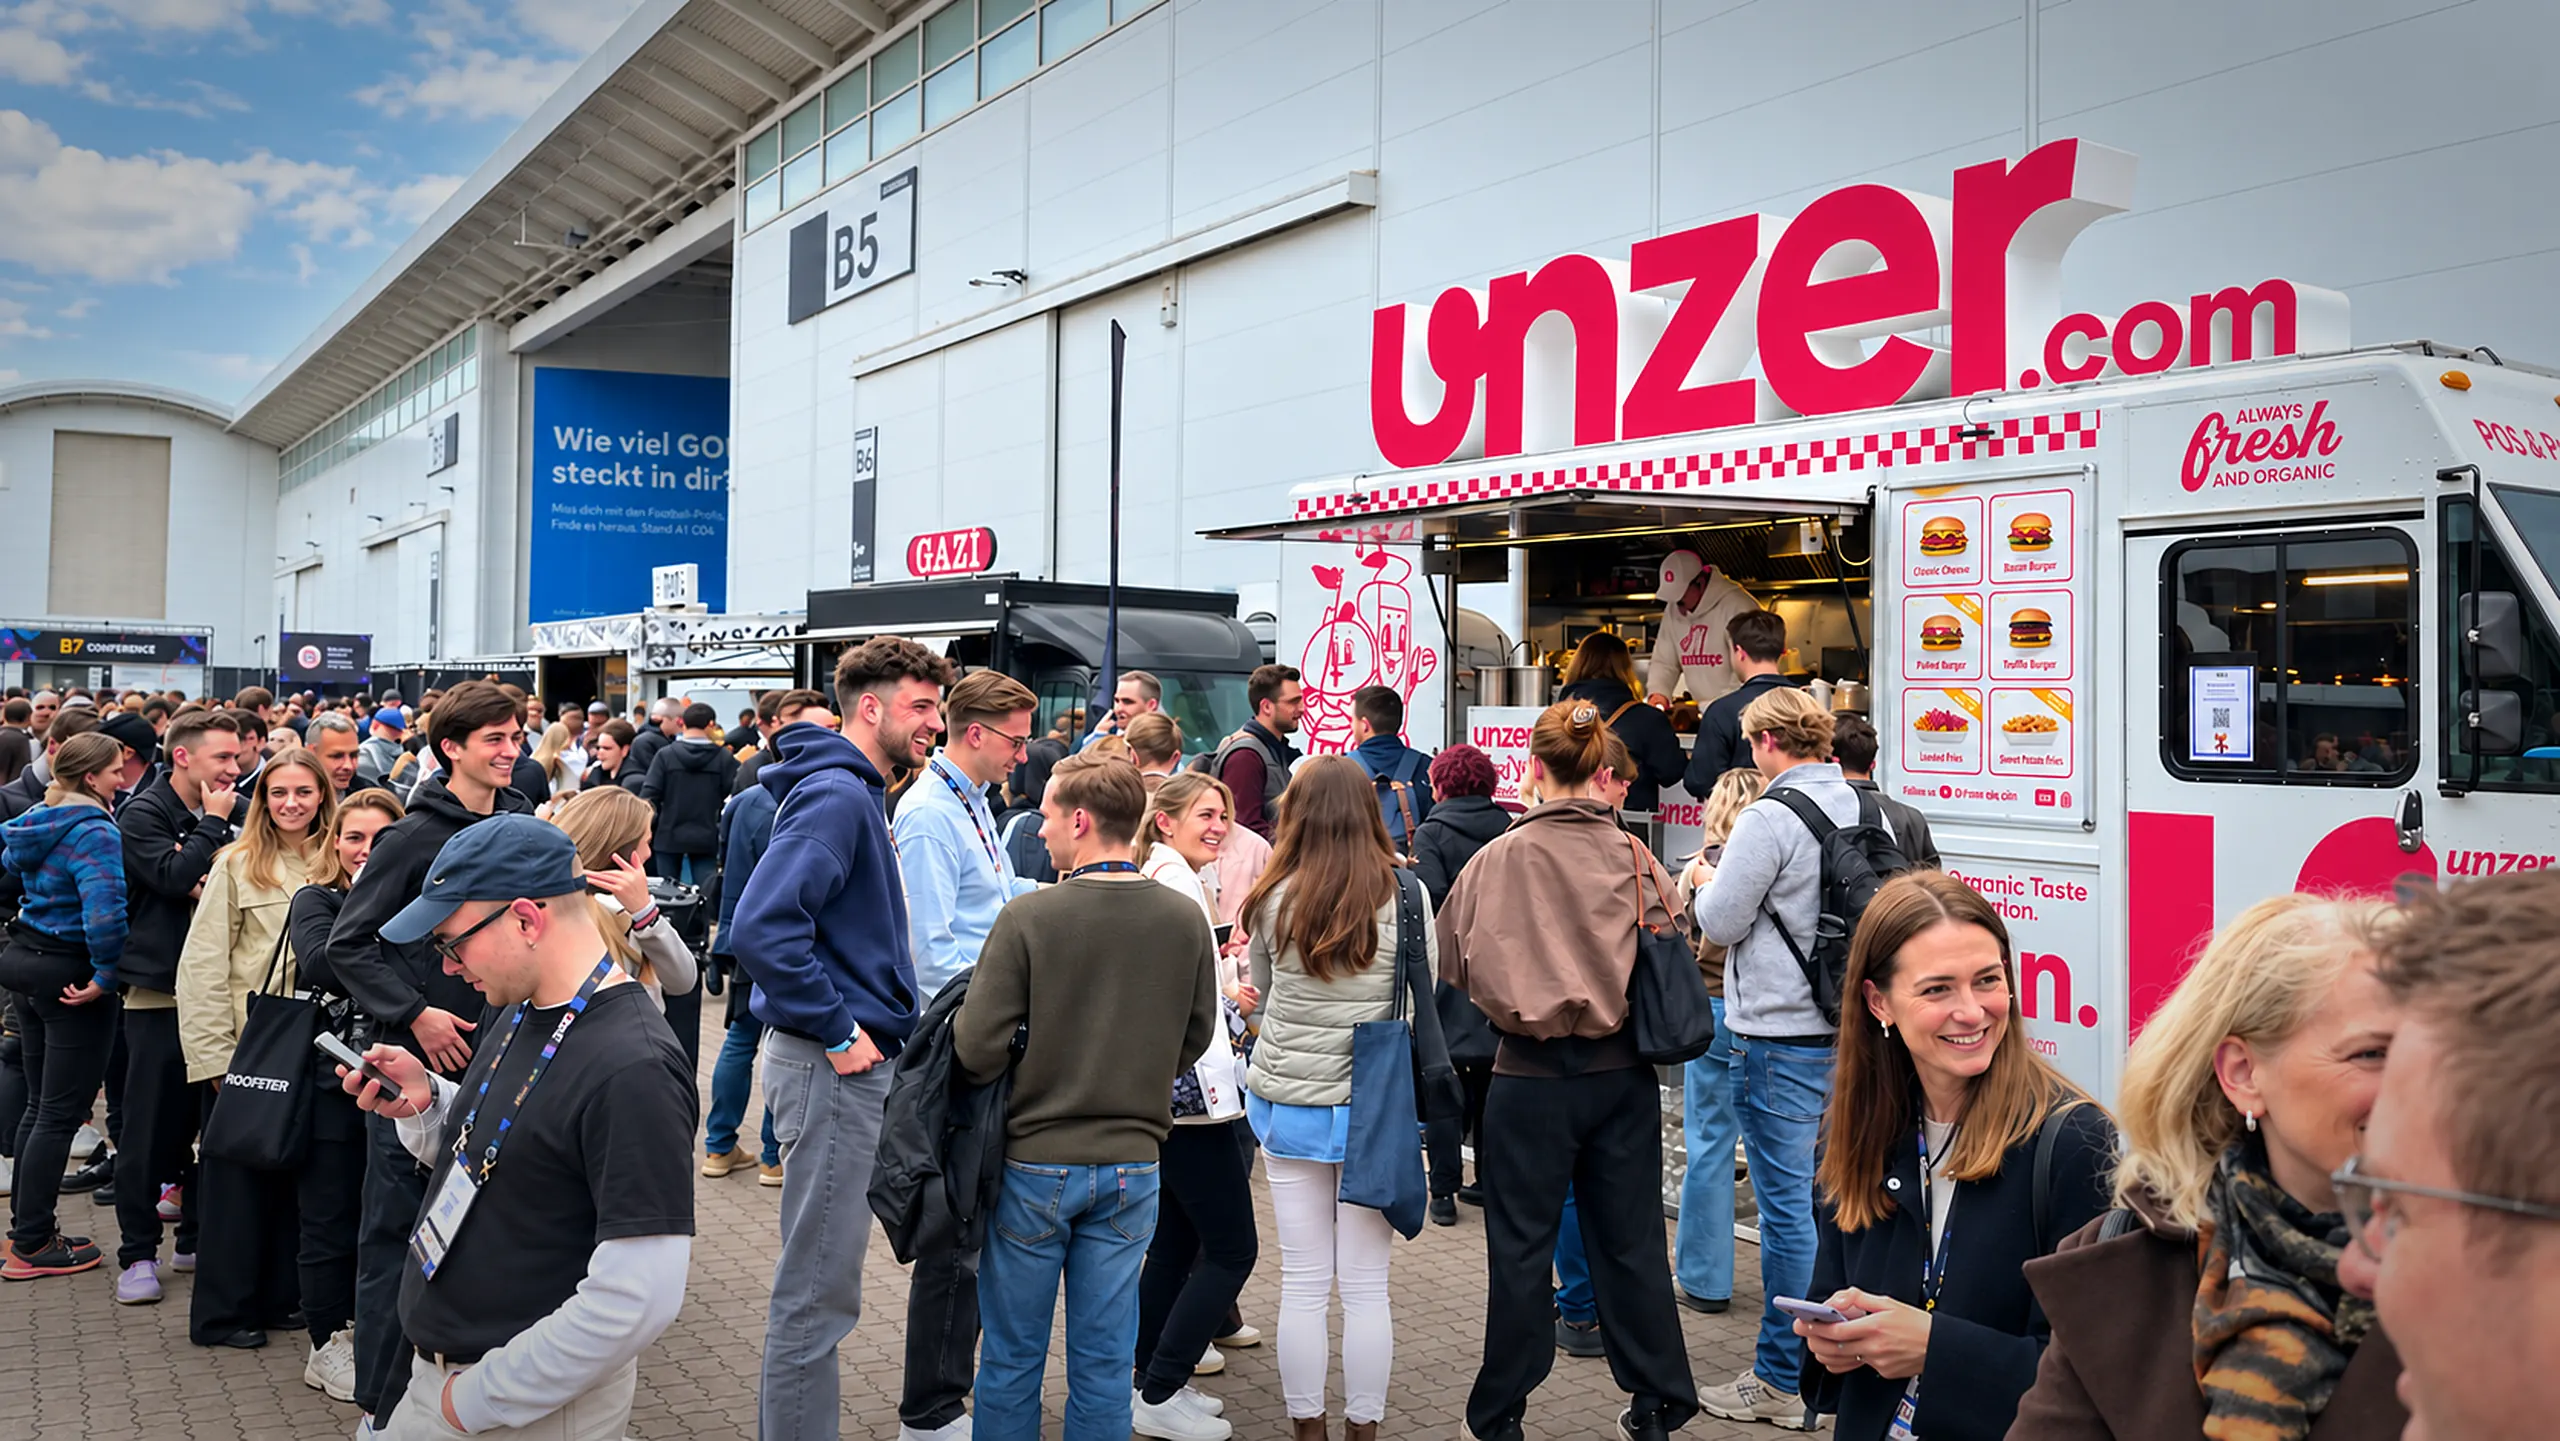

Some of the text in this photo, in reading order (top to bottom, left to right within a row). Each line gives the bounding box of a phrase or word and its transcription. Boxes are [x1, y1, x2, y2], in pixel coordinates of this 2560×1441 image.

[834, 211, 878, 291] B5
[2236, 403, 2303, 425] ALWAYS
[553, 426, 729, 459] Wie viel GO
[2181, 400, 2343, 492] fresh
[2473, 419, 2560, 460] POS & P
[856, 447, 873, 473] B6
[552, 462, 643, 487] steckt
[651, 464, 675, 489] in
[2212, 463, 2336, 488] AND ORGANIC
[605, 505, 623, 516] mit
[551, 519, 582, 531] Finde
[584, 523, 597, 531] es
[641, 522, 672, 534] Stand
[60, 638, 156, 655] B7 CONFERENCE
[2446, 850, 2556, 876] unzer
[2030, 876, 2088, 901] Taste
